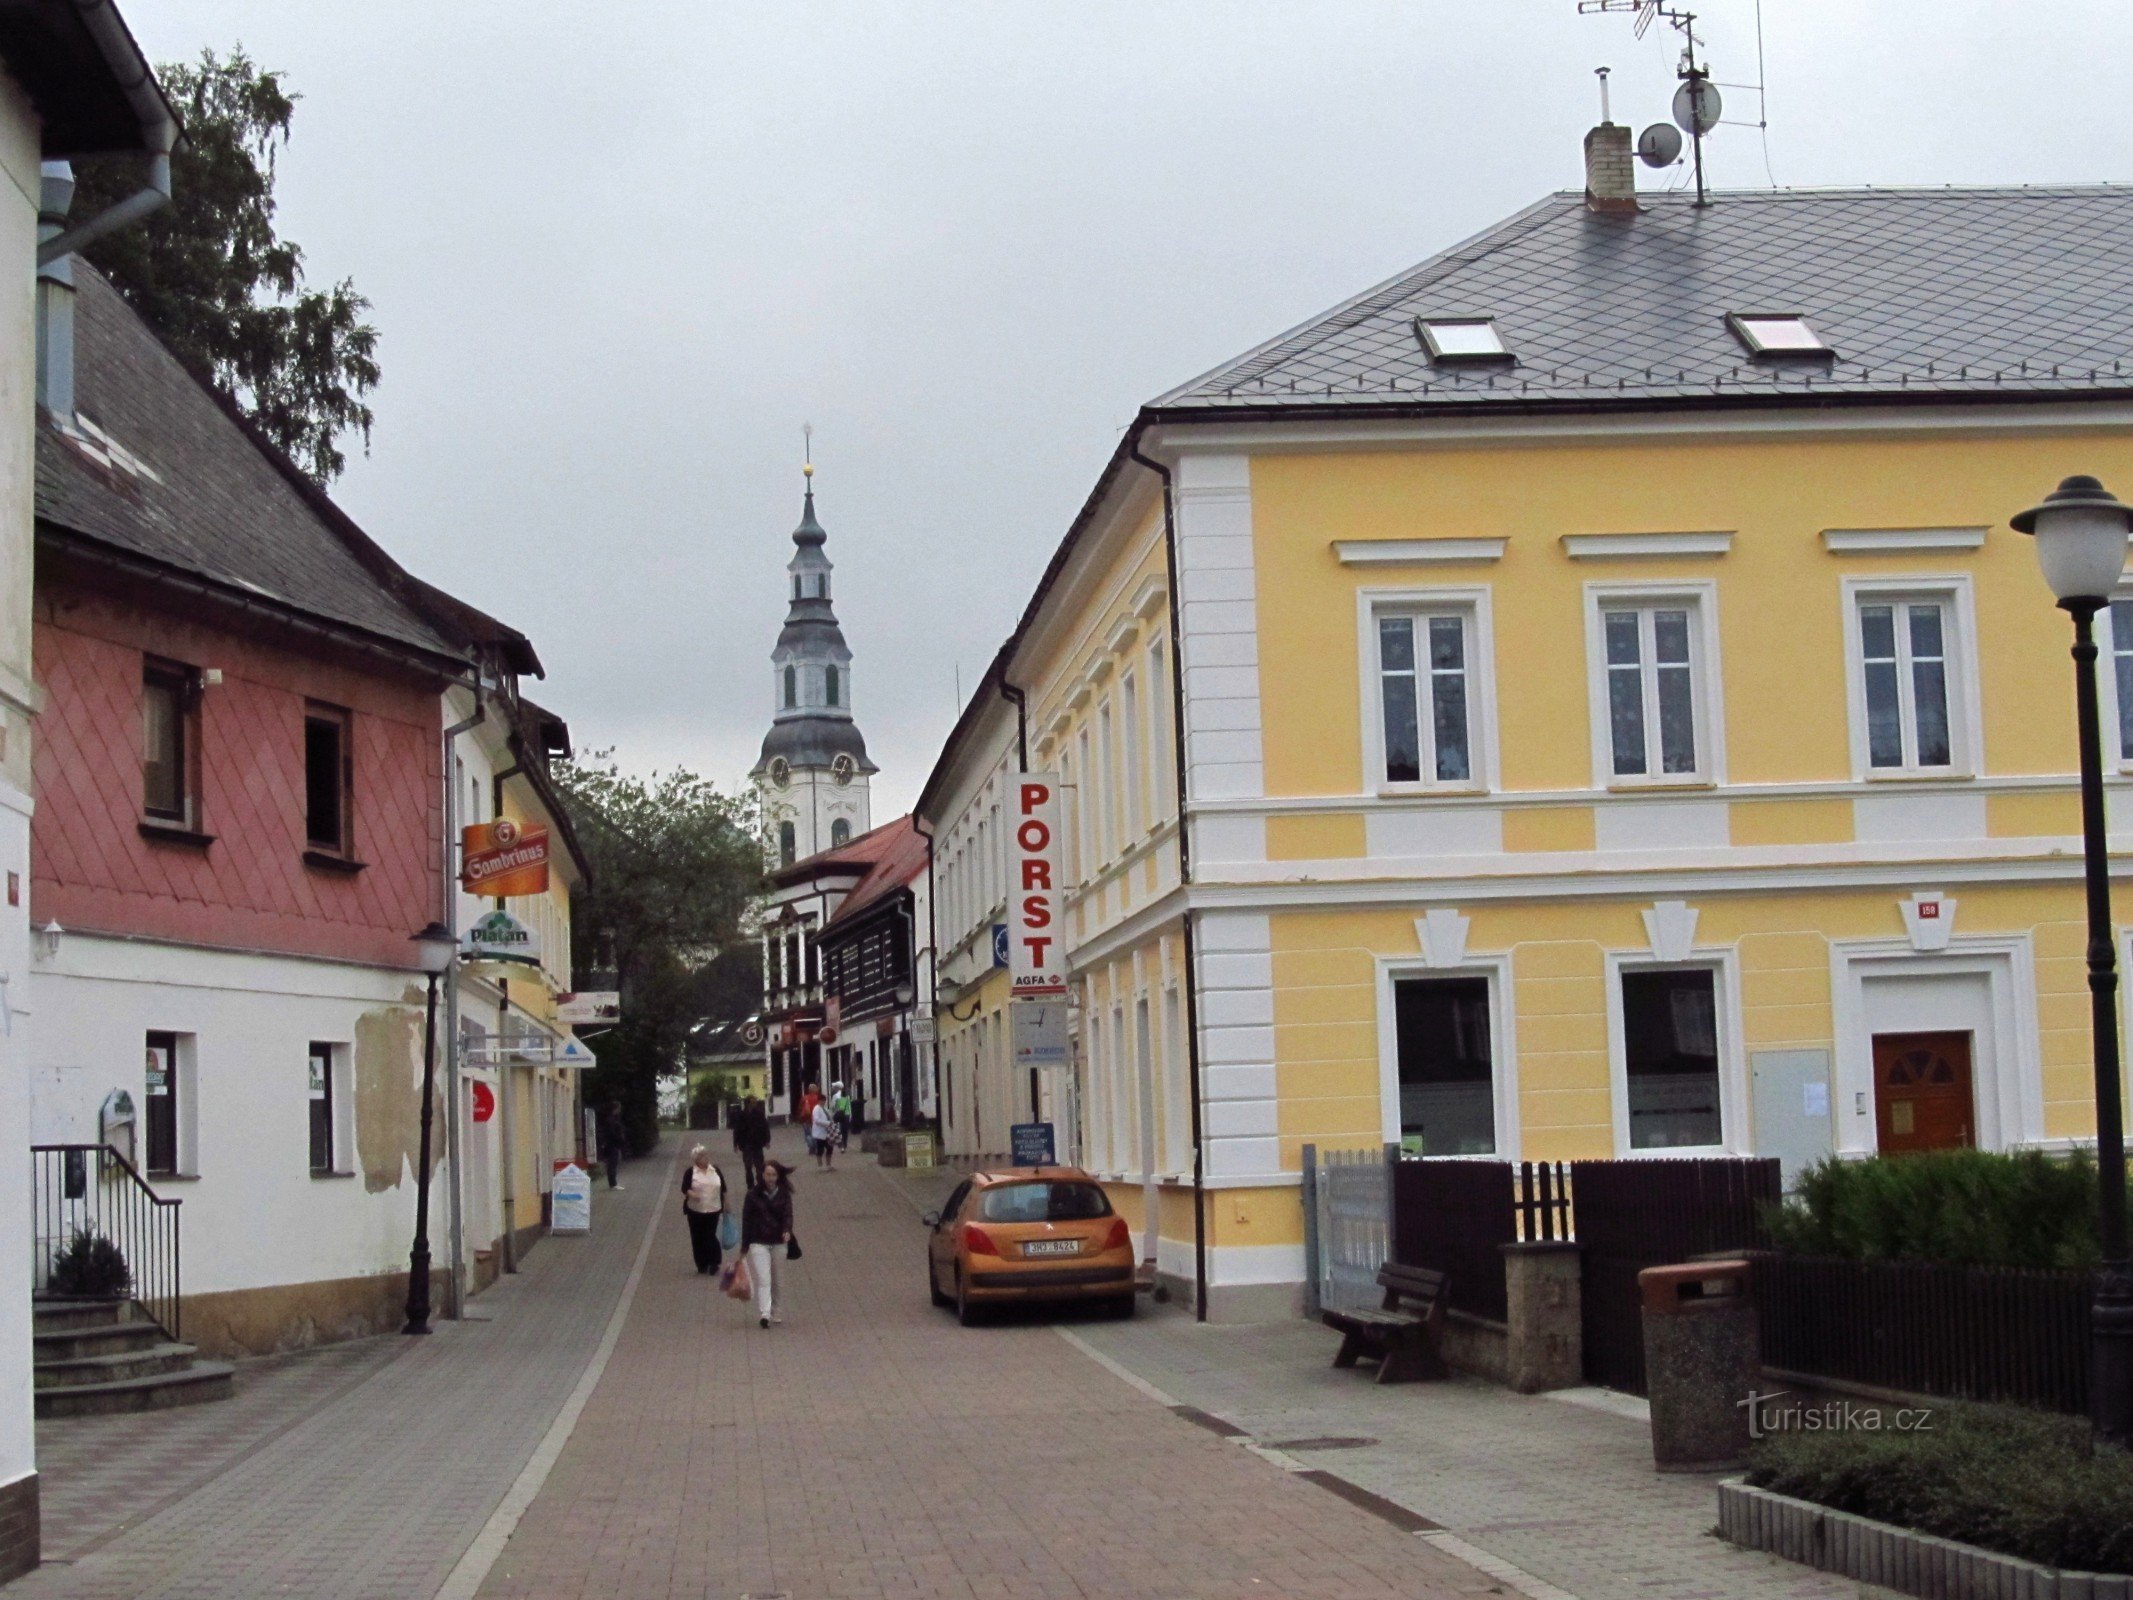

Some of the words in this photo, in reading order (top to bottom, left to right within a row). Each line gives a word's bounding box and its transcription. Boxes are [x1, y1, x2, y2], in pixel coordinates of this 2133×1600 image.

[468, 844, 544, 879] Gambrinus
[1017, 783, 1052, 968] PORST
[1922, 905, 1936, 915] 158
[470, 929, 528, 943] Platan
[1016, 975, 1045, 985] AGFA
